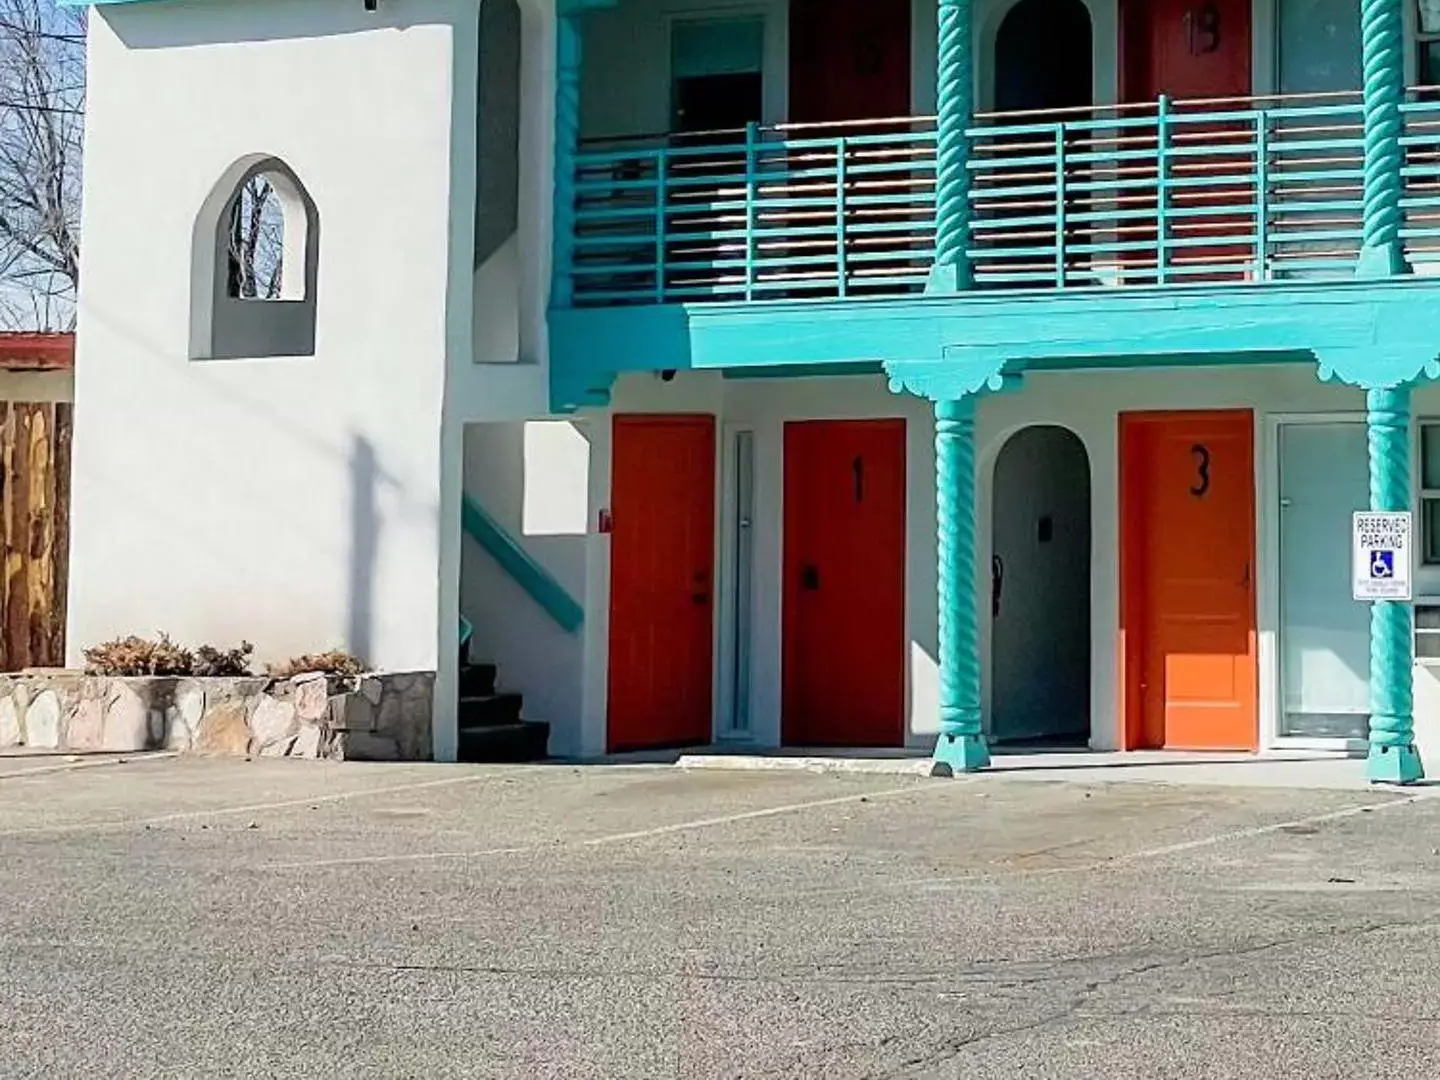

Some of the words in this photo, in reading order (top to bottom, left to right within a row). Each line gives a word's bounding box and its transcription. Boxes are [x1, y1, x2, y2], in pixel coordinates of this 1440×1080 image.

[852, 455, 863, 503] 1
[1190, 443, 1209, 497] 3
[1357, 518, 1407, 533] RESERVED
[1361, 534, 1402, 549] PARKING
